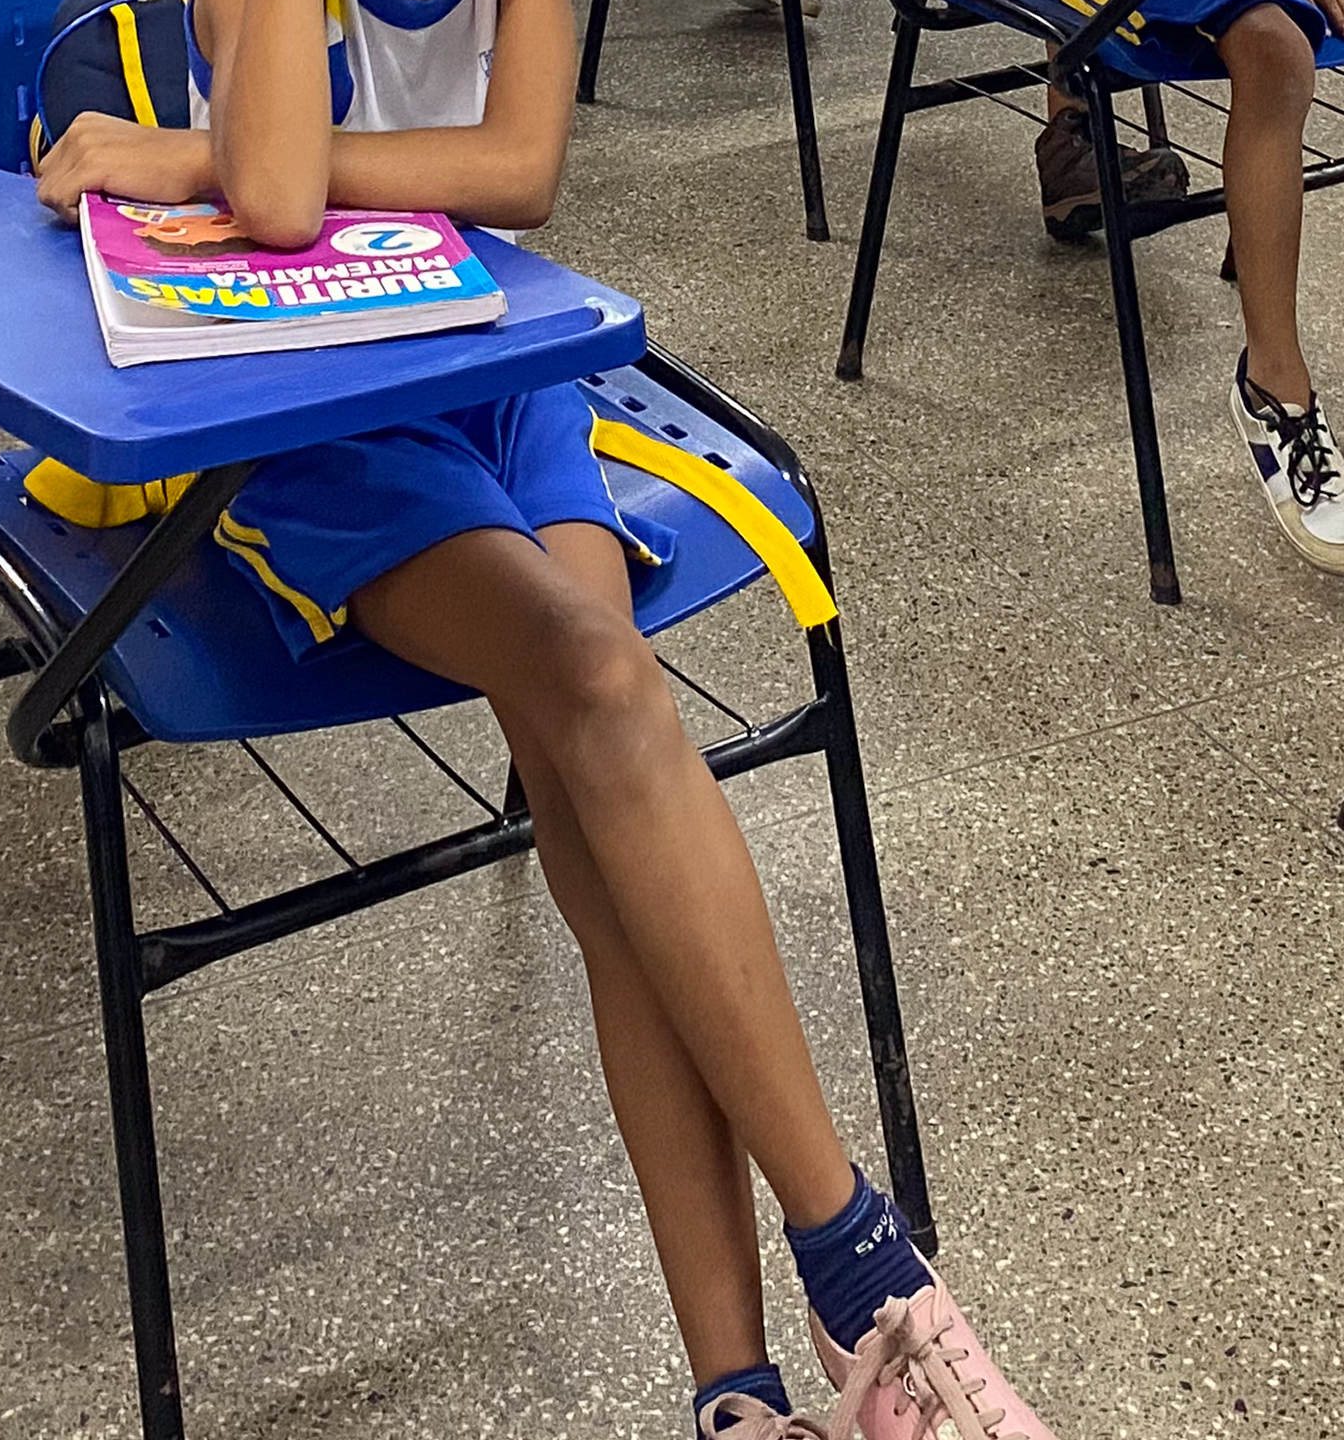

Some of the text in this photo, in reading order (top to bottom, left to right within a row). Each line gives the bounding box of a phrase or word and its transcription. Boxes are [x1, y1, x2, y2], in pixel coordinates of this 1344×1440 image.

[128, 269, 462, 308] BURITI MAIS
[208, 255, 448, 287] MATEMÁTICA
